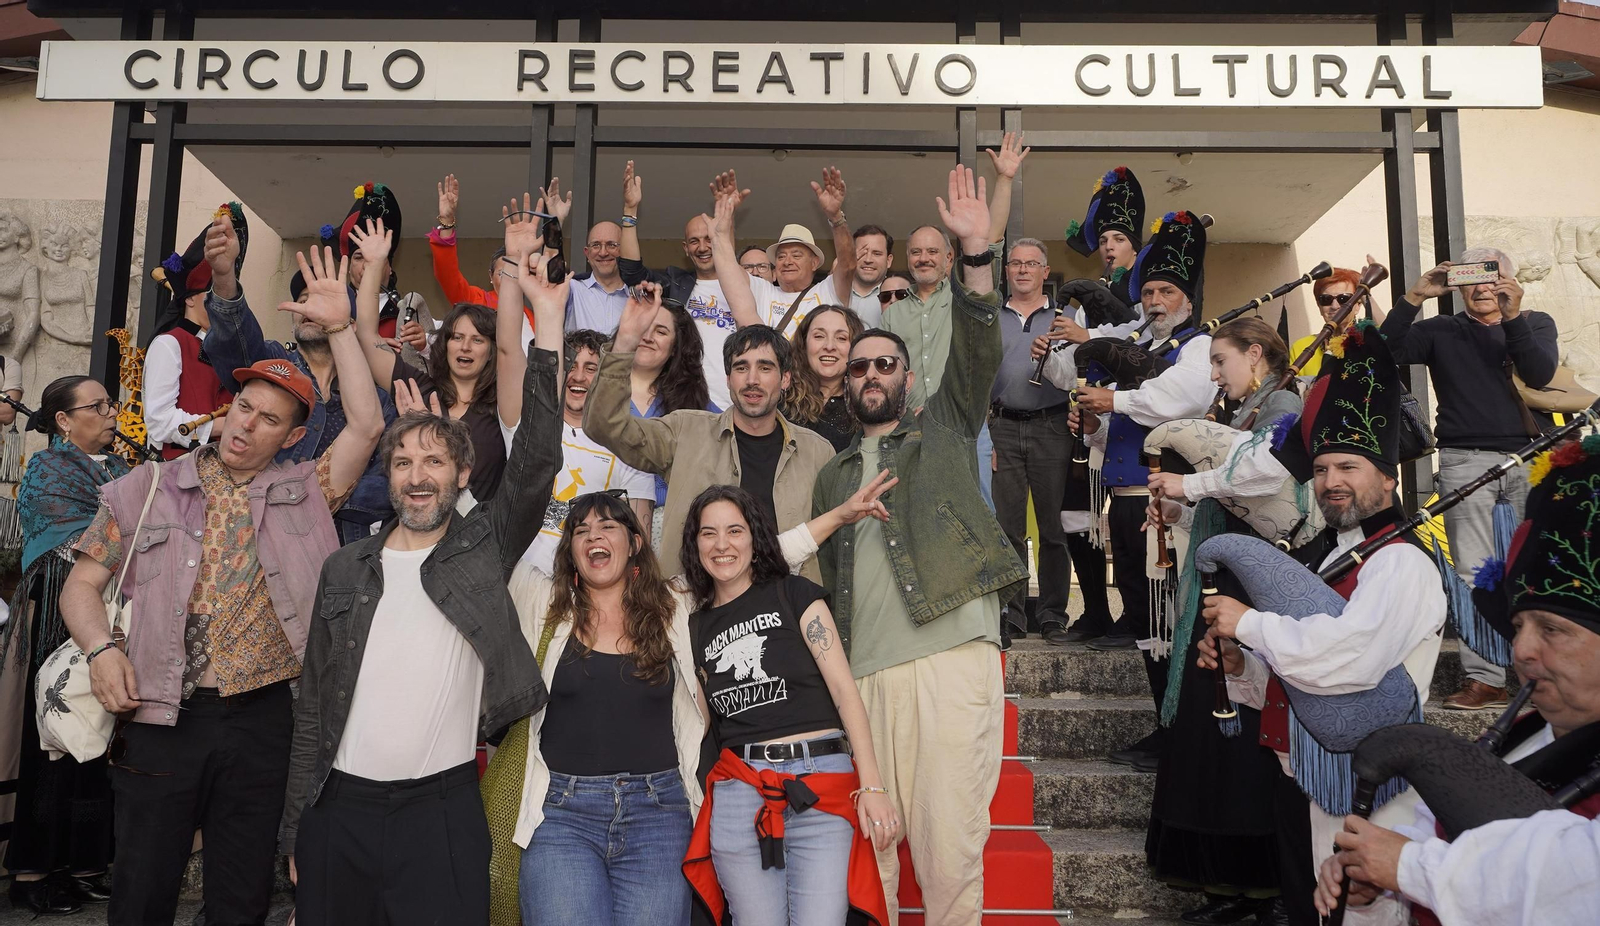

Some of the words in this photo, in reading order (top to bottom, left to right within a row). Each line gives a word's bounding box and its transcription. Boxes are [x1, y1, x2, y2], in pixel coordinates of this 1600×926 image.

[124, 47, 426, 92] CIRCULO
[517, 49, 979, 97] RECREATIVO
[1076, 54, 1453, 99] CULTURAL
[704, 629, 730, 658] BLACK
[729, 611, 783, 643] MANTERS
